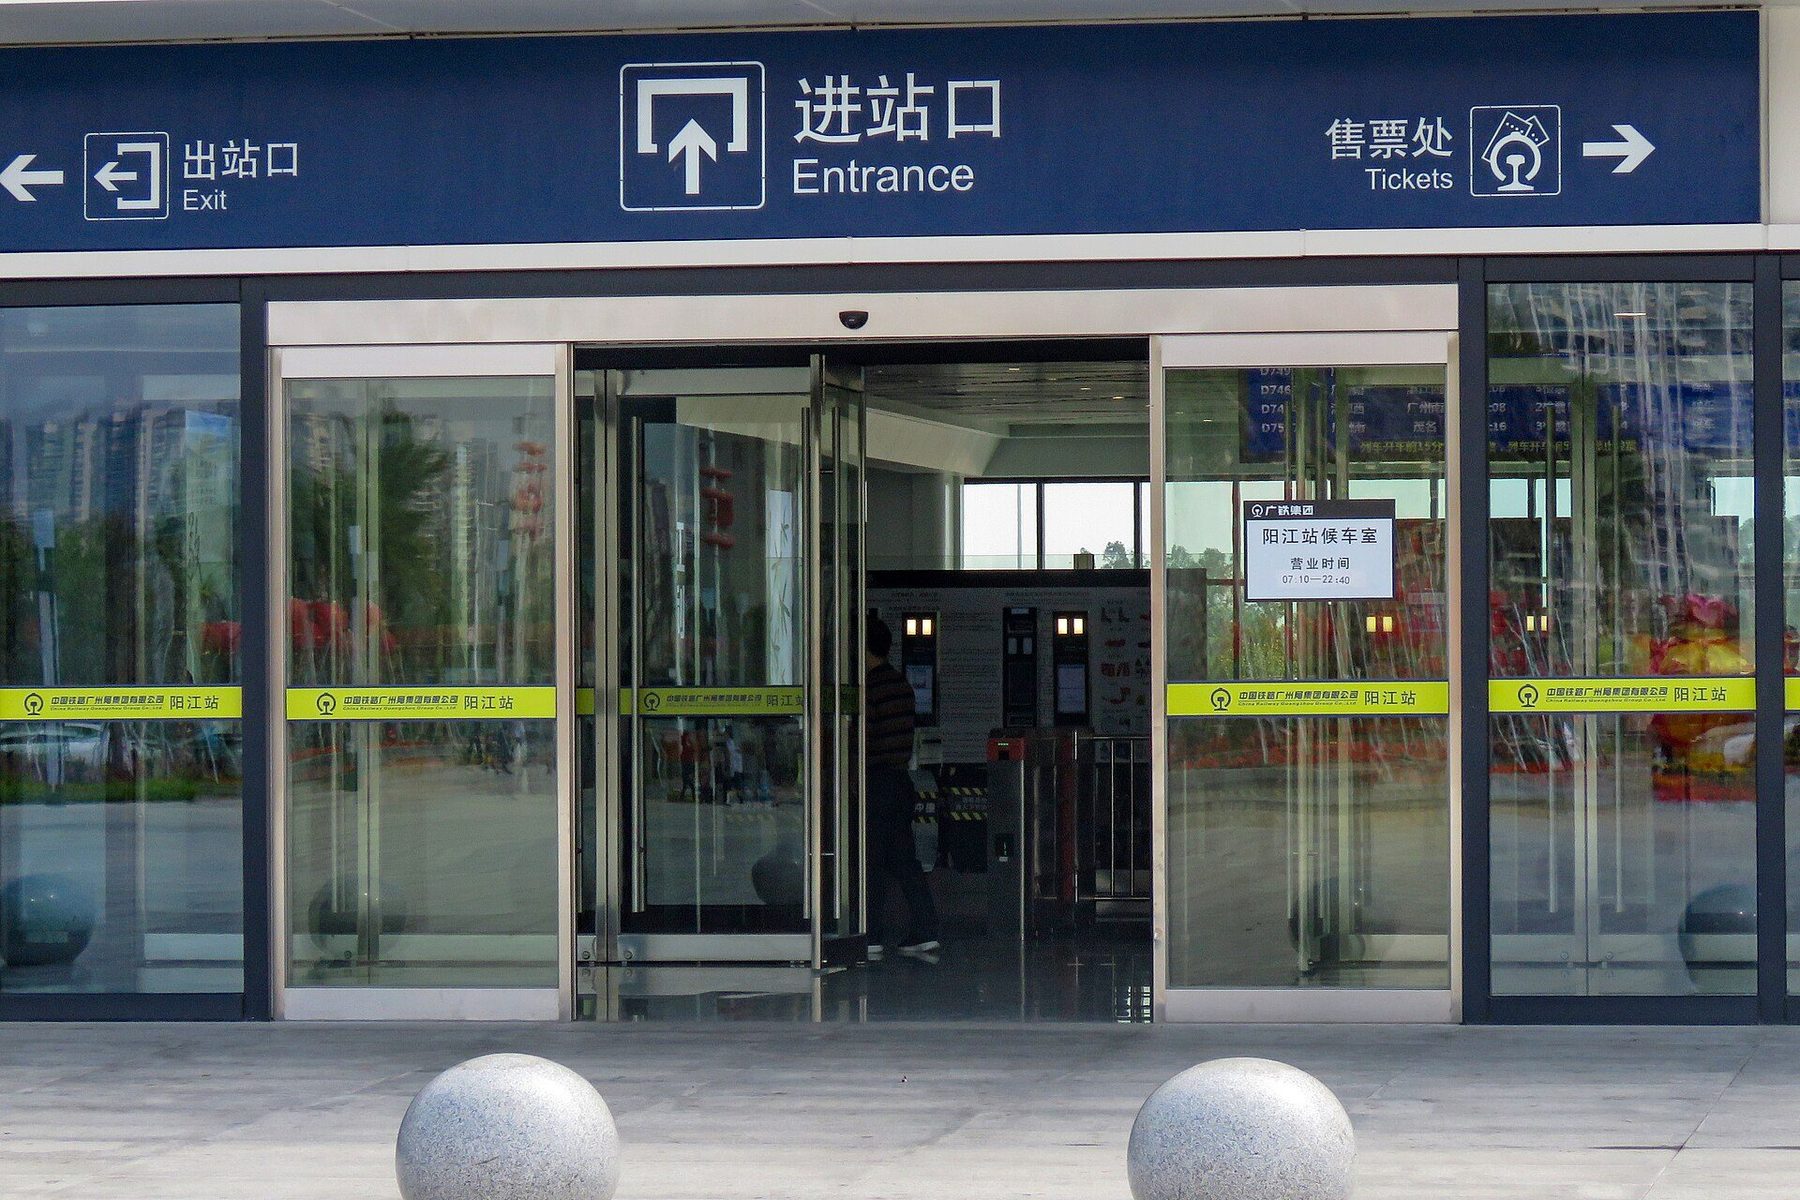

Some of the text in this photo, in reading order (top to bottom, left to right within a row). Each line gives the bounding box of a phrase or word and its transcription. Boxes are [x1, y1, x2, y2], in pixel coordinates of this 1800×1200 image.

[794, 73, 1001, 143] 进站口
[1325, 117, 1453, 160] 售票处
[184, 139, 299, 180] 出站口
[793, 158, 974, 194] Entrance
[1365, 168, 1453, 190] Tickets
[183, 189, 227, 211] Exit
[1265, 505, 1314, 516] 广铁集团
[1262, 527, 1378, 545] 阳江站候车室
[1290, 557, 1350, 571] 营业时间
[170, 695, 219, 710] 阳江站
[465, 695, 514, 710] 阳江站
[1364, 690, 1417, 706] 阳江站
[1674, 687, 1727, 702] 阳江站
